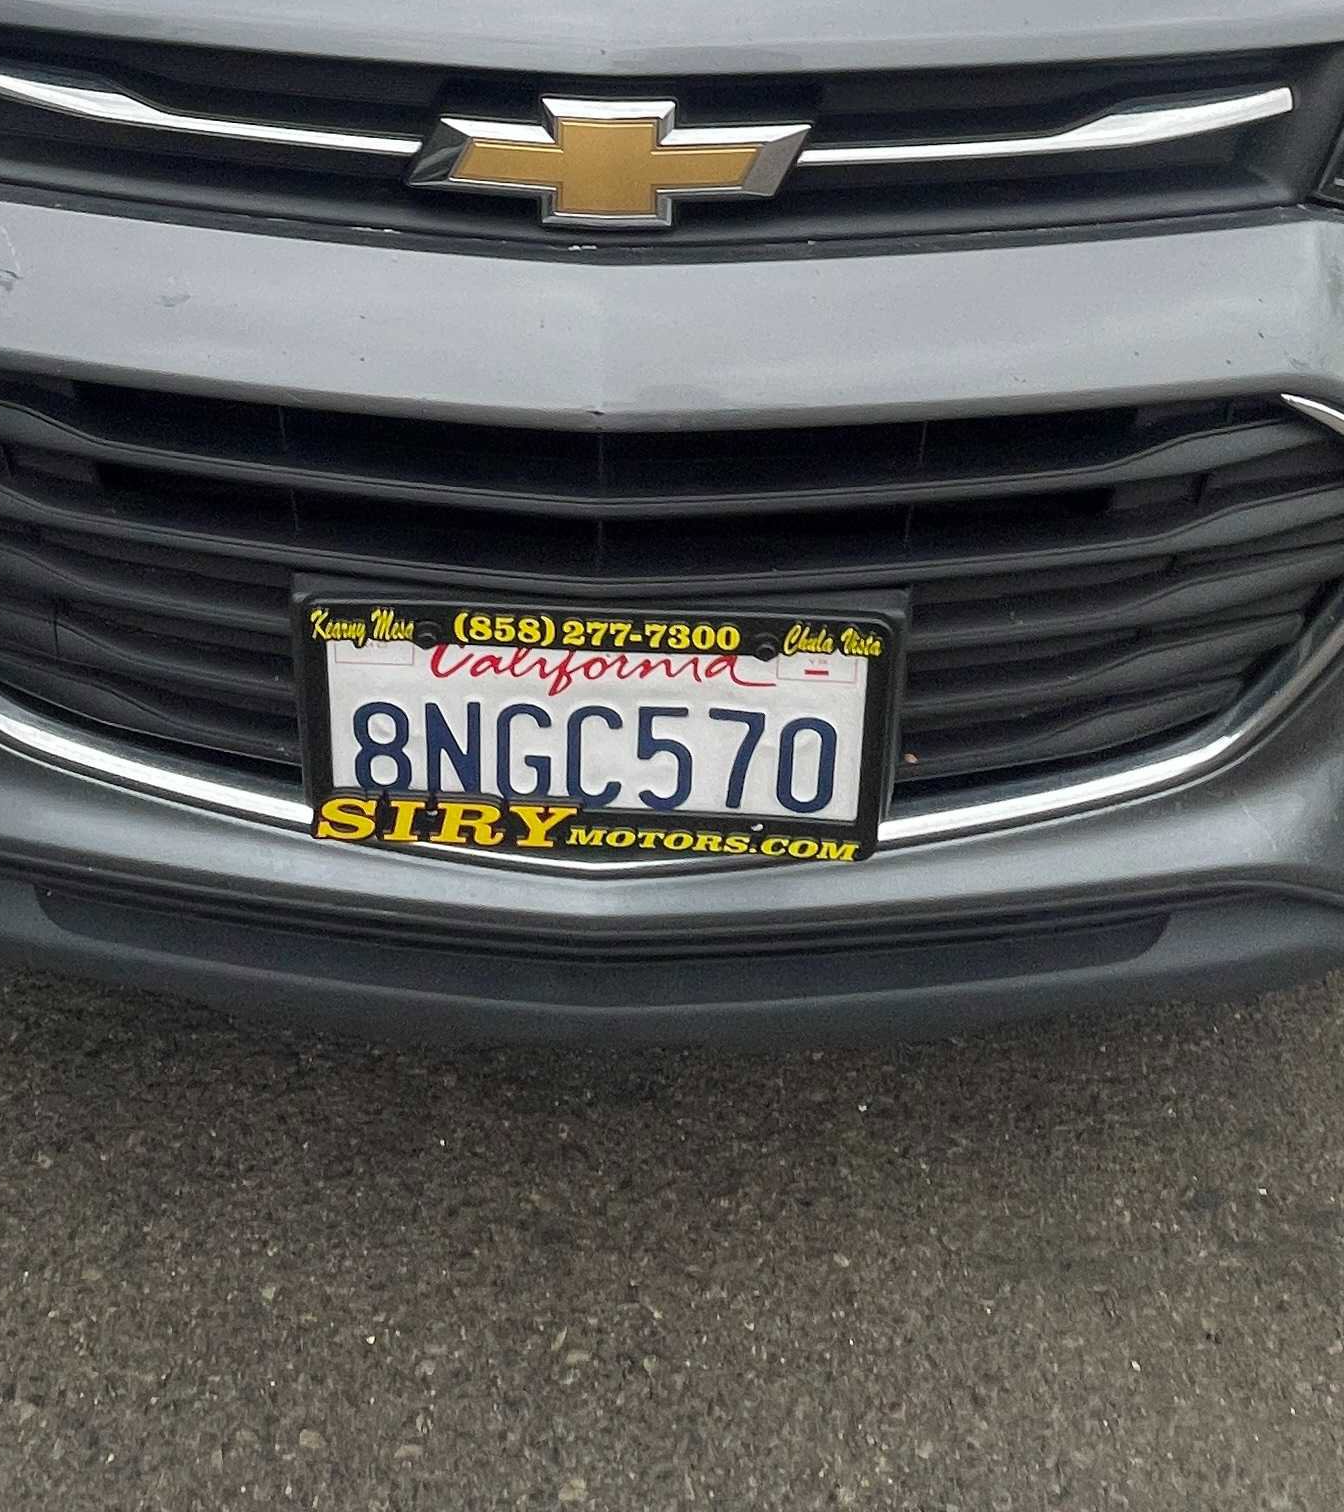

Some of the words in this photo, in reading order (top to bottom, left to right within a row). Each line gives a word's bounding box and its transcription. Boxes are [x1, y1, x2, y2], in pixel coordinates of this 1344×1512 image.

[370, 607, 414, 640] Mesa
[454, 612, 555, 647] (858)
[562, 619, 741, 651] 277-7300
[430, 641, 776, 696] California
[353, 701, 838, 813] 8NGC570
[316, 797, 577, 848] SIRY
[566, 826, 859, 862] MOTORS.COM
